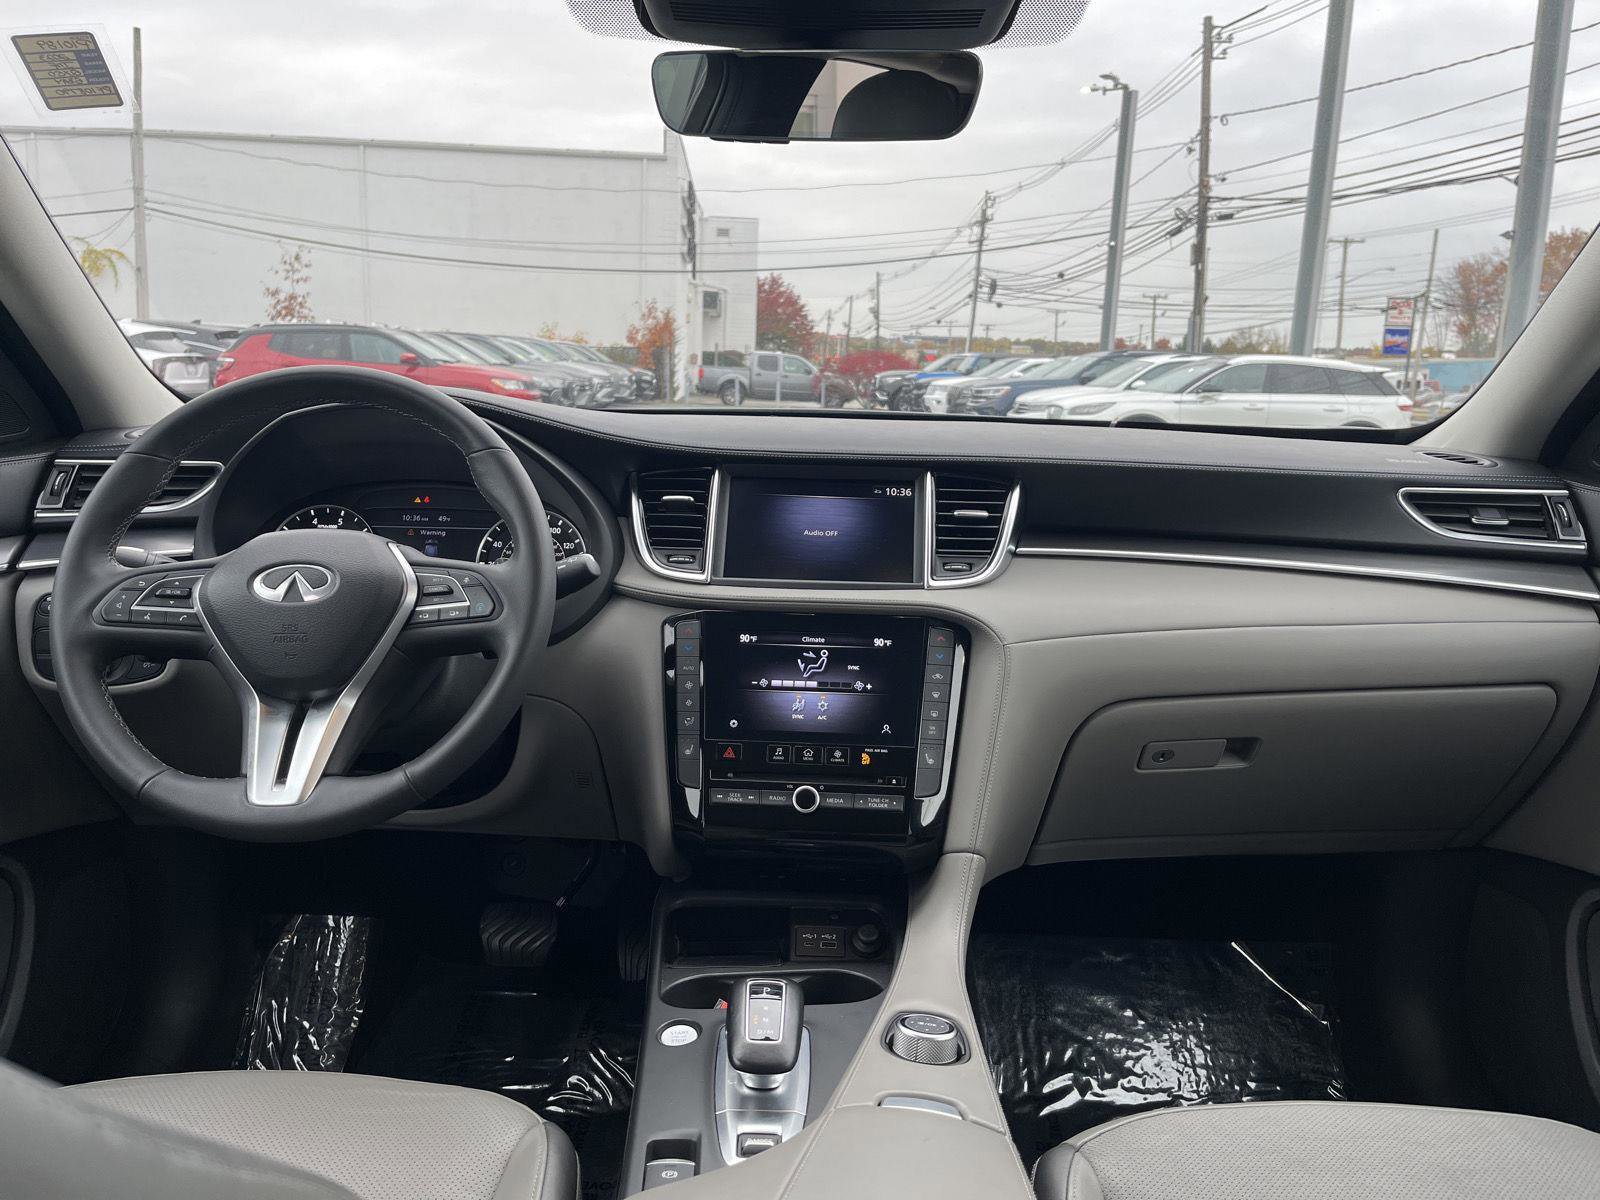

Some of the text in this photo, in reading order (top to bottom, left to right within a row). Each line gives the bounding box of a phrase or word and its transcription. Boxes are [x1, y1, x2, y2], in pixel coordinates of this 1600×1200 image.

[885, 487, 912, 497] 10:36
[803, 529, 824, 537] Audio
[801, 636, 826, 644] Climate
